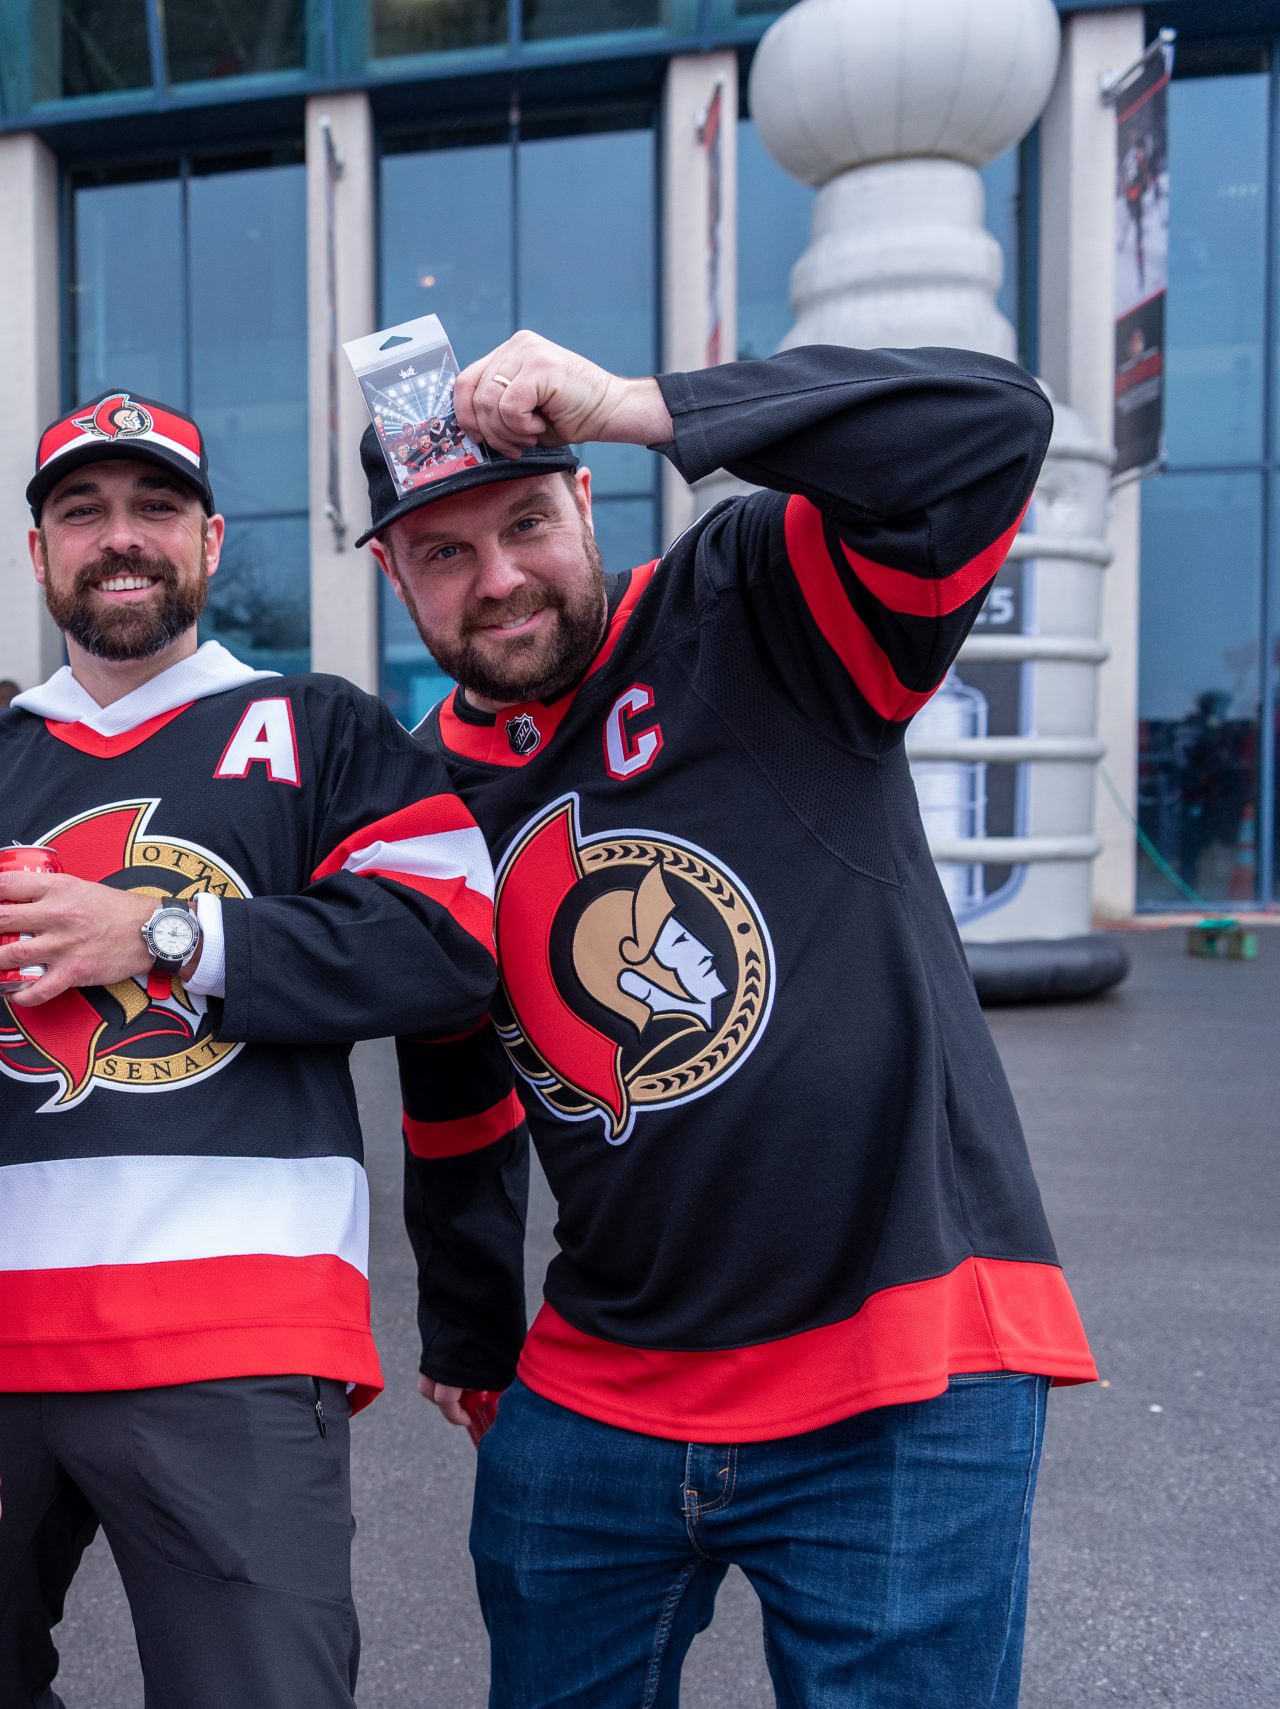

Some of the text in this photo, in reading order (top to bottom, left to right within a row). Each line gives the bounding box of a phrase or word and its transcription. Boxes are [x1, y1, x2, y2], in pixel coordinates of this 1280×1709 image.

[212, 696, 302, 788] A
[515, 724, 532, 749] NHL
[602, 681, 665, 782] C
